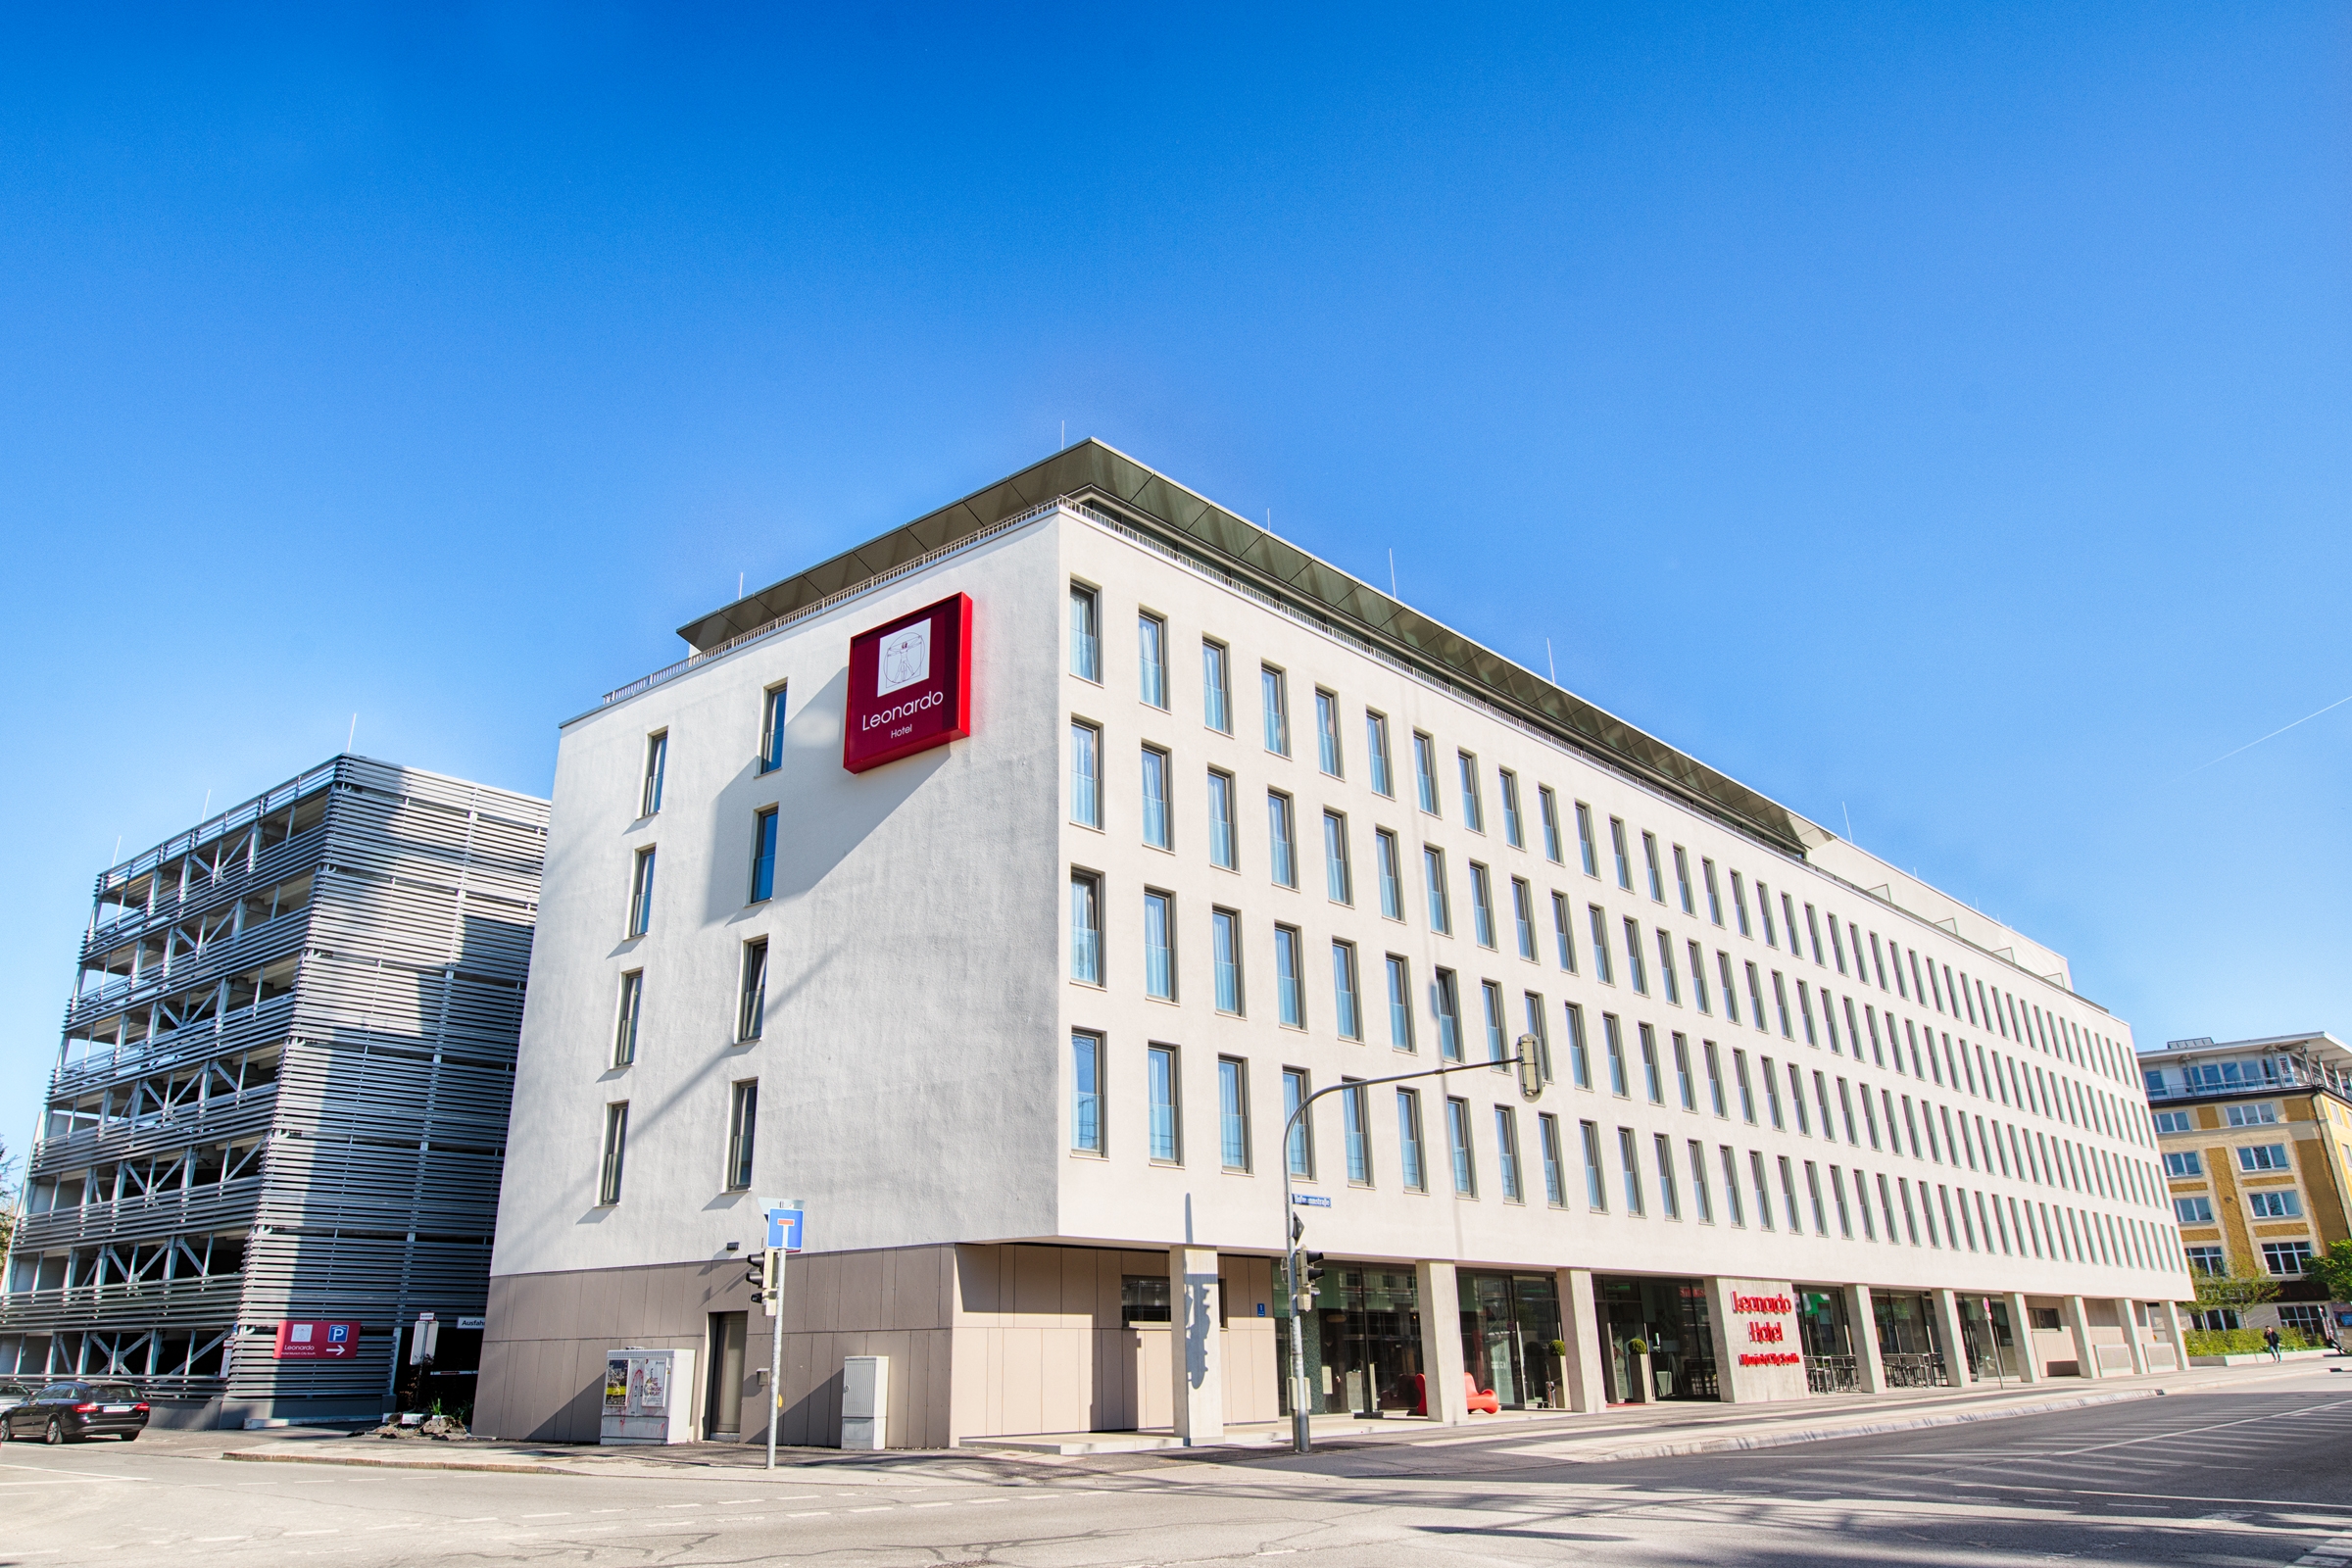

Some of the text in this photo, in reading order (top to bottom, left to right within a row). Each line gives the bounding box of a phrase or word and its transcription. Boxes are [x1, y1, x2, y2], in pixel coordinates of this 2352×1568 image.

[861, 690, 944, 732] Leonardo
[890, 723, 912, 739] Hotel
[1294, 1195, 1330, 1206] Hofmnnstraße
[1731, 1291, 1792, 1314] Leonardo
[1748, 1321, 1784, 1343] Hotel
